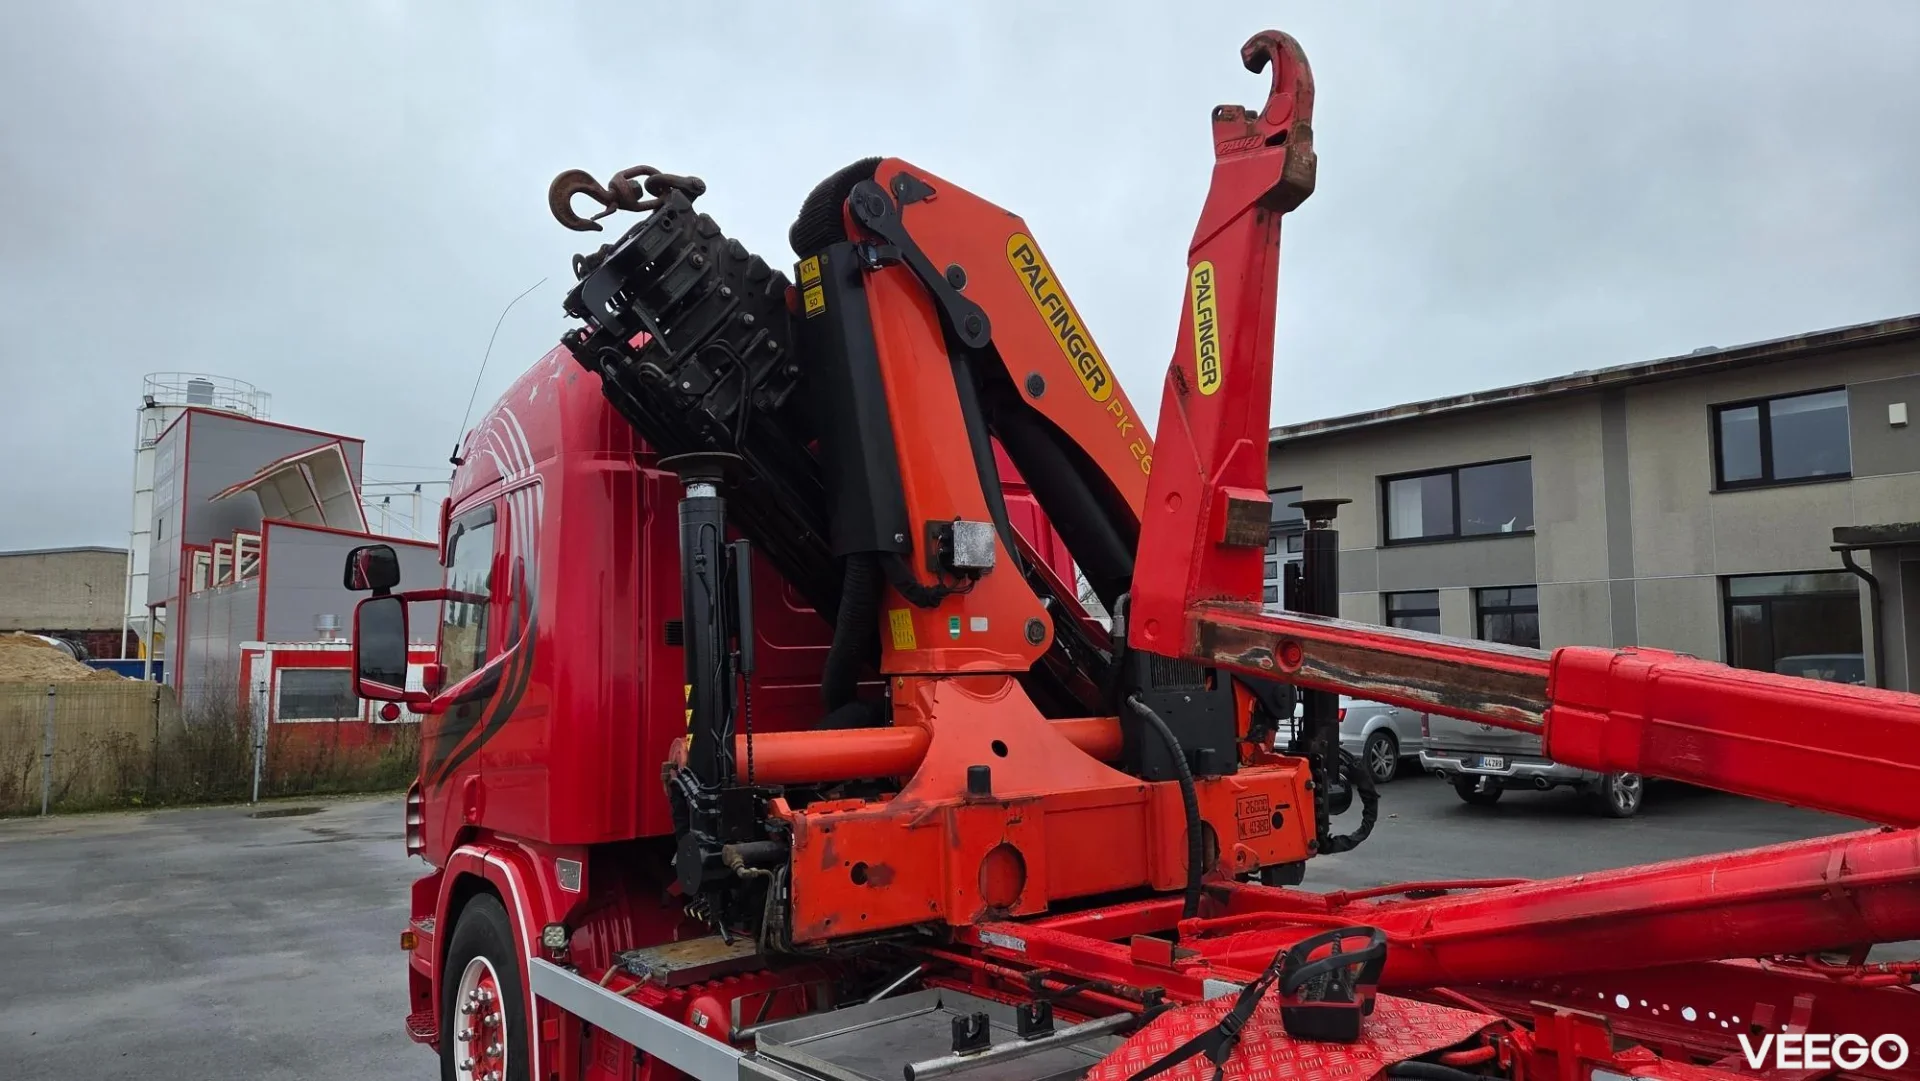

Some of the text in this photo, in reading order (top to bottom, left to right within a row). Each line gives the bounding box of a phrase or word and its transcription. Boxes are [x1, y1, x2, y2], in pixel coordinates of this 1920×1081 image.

[1012, 242, 1106, 394] PALFINGER
[1194, 267, 1218, 388] PALFINGER
[1106, 398, 1134, 437] PK
